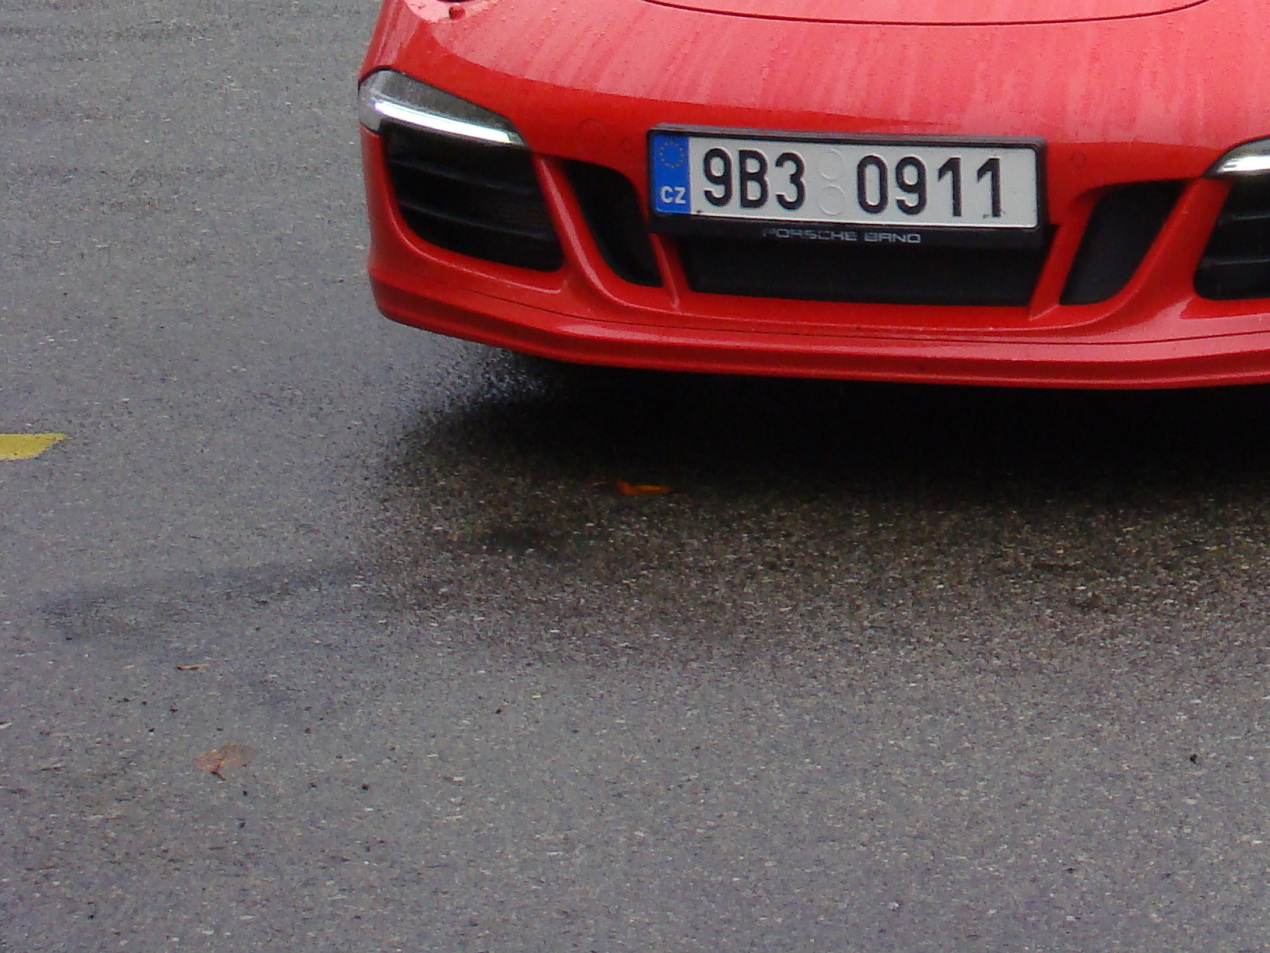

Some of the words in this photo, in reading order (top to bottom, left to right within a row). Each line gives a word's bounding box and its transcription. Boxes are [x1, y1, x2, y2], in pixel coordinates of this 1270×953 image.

[702, 146, 806, 211] 9B3
[855, 154, 1004, 219] 0911
[659, 185, 687, 205] CZ
[762, 228, 858, 242] PORSCHE
[864, 231, 922, 244] BRNO
